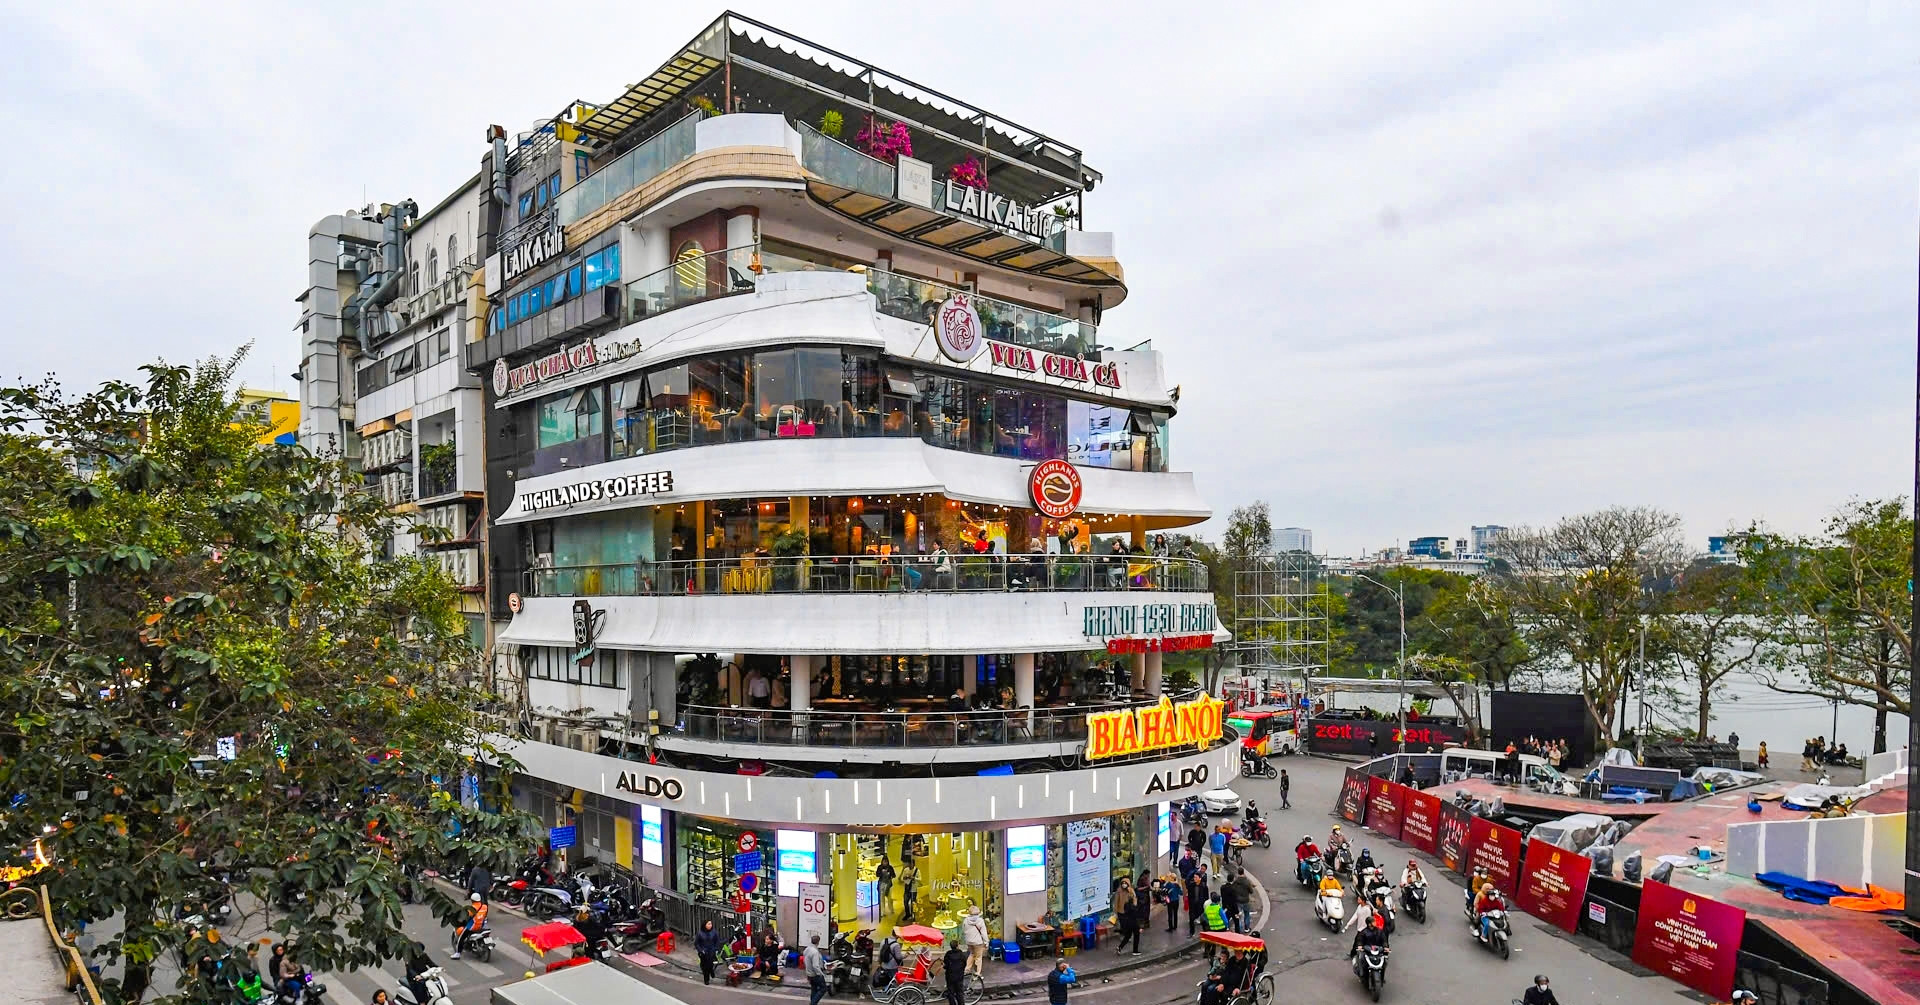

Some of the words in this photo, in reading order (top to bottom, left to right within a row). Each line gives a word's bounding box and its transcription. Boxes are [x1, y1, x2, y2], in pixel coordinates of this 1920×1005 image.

[946, 179, 1021, 229] LAIKA
[504, 235, 543, 280] LAIKA
[544, 226, 565, 258] Café
[509, 362, 536, 390] VUA
[539, 344, 570, 381] CHẢ
[572, 338, 596, 368] CÁ
[989, 341, 1037, 373] VUA
[1042, 353, 1089, 383] CHẢ
[1093, 361, 1122, 389] CÁ
[1036, 463, 1080, 488] HIGHLANDS
[520, 481, 600, 511] HIGHLANDS
[603, 471, 673, 498] COFFEE
[1040, 500, 1075, 514] COFFEE
[1084, 605, 1138, 636] HANOI
[1143, 604, 1178, 633] 1930
[1180, 604, 1217, 632] BISTRO
[1090, 711, 1139, 758] BIA
[1140, 696, 1178, 750] HÀ
[1179, 692, 1224, 751] NỘI
[616, 770, 683, 799] ALDO
[1145, 764, 1208, 795] ALDO
[1076, 836, 1102, 862] 50
[803, 898, 825, 914] 50
[1654, 920, 1673, 932] CÔNG
[1673, 928, 1683, 936] AN
[1683, 931, 1701, 943] NHÂN
[1702, 938, 1718, 950] DÂN
[1683, 924, 1706, 938] QUANG
[1683, 939, 1699, 950] NAM
